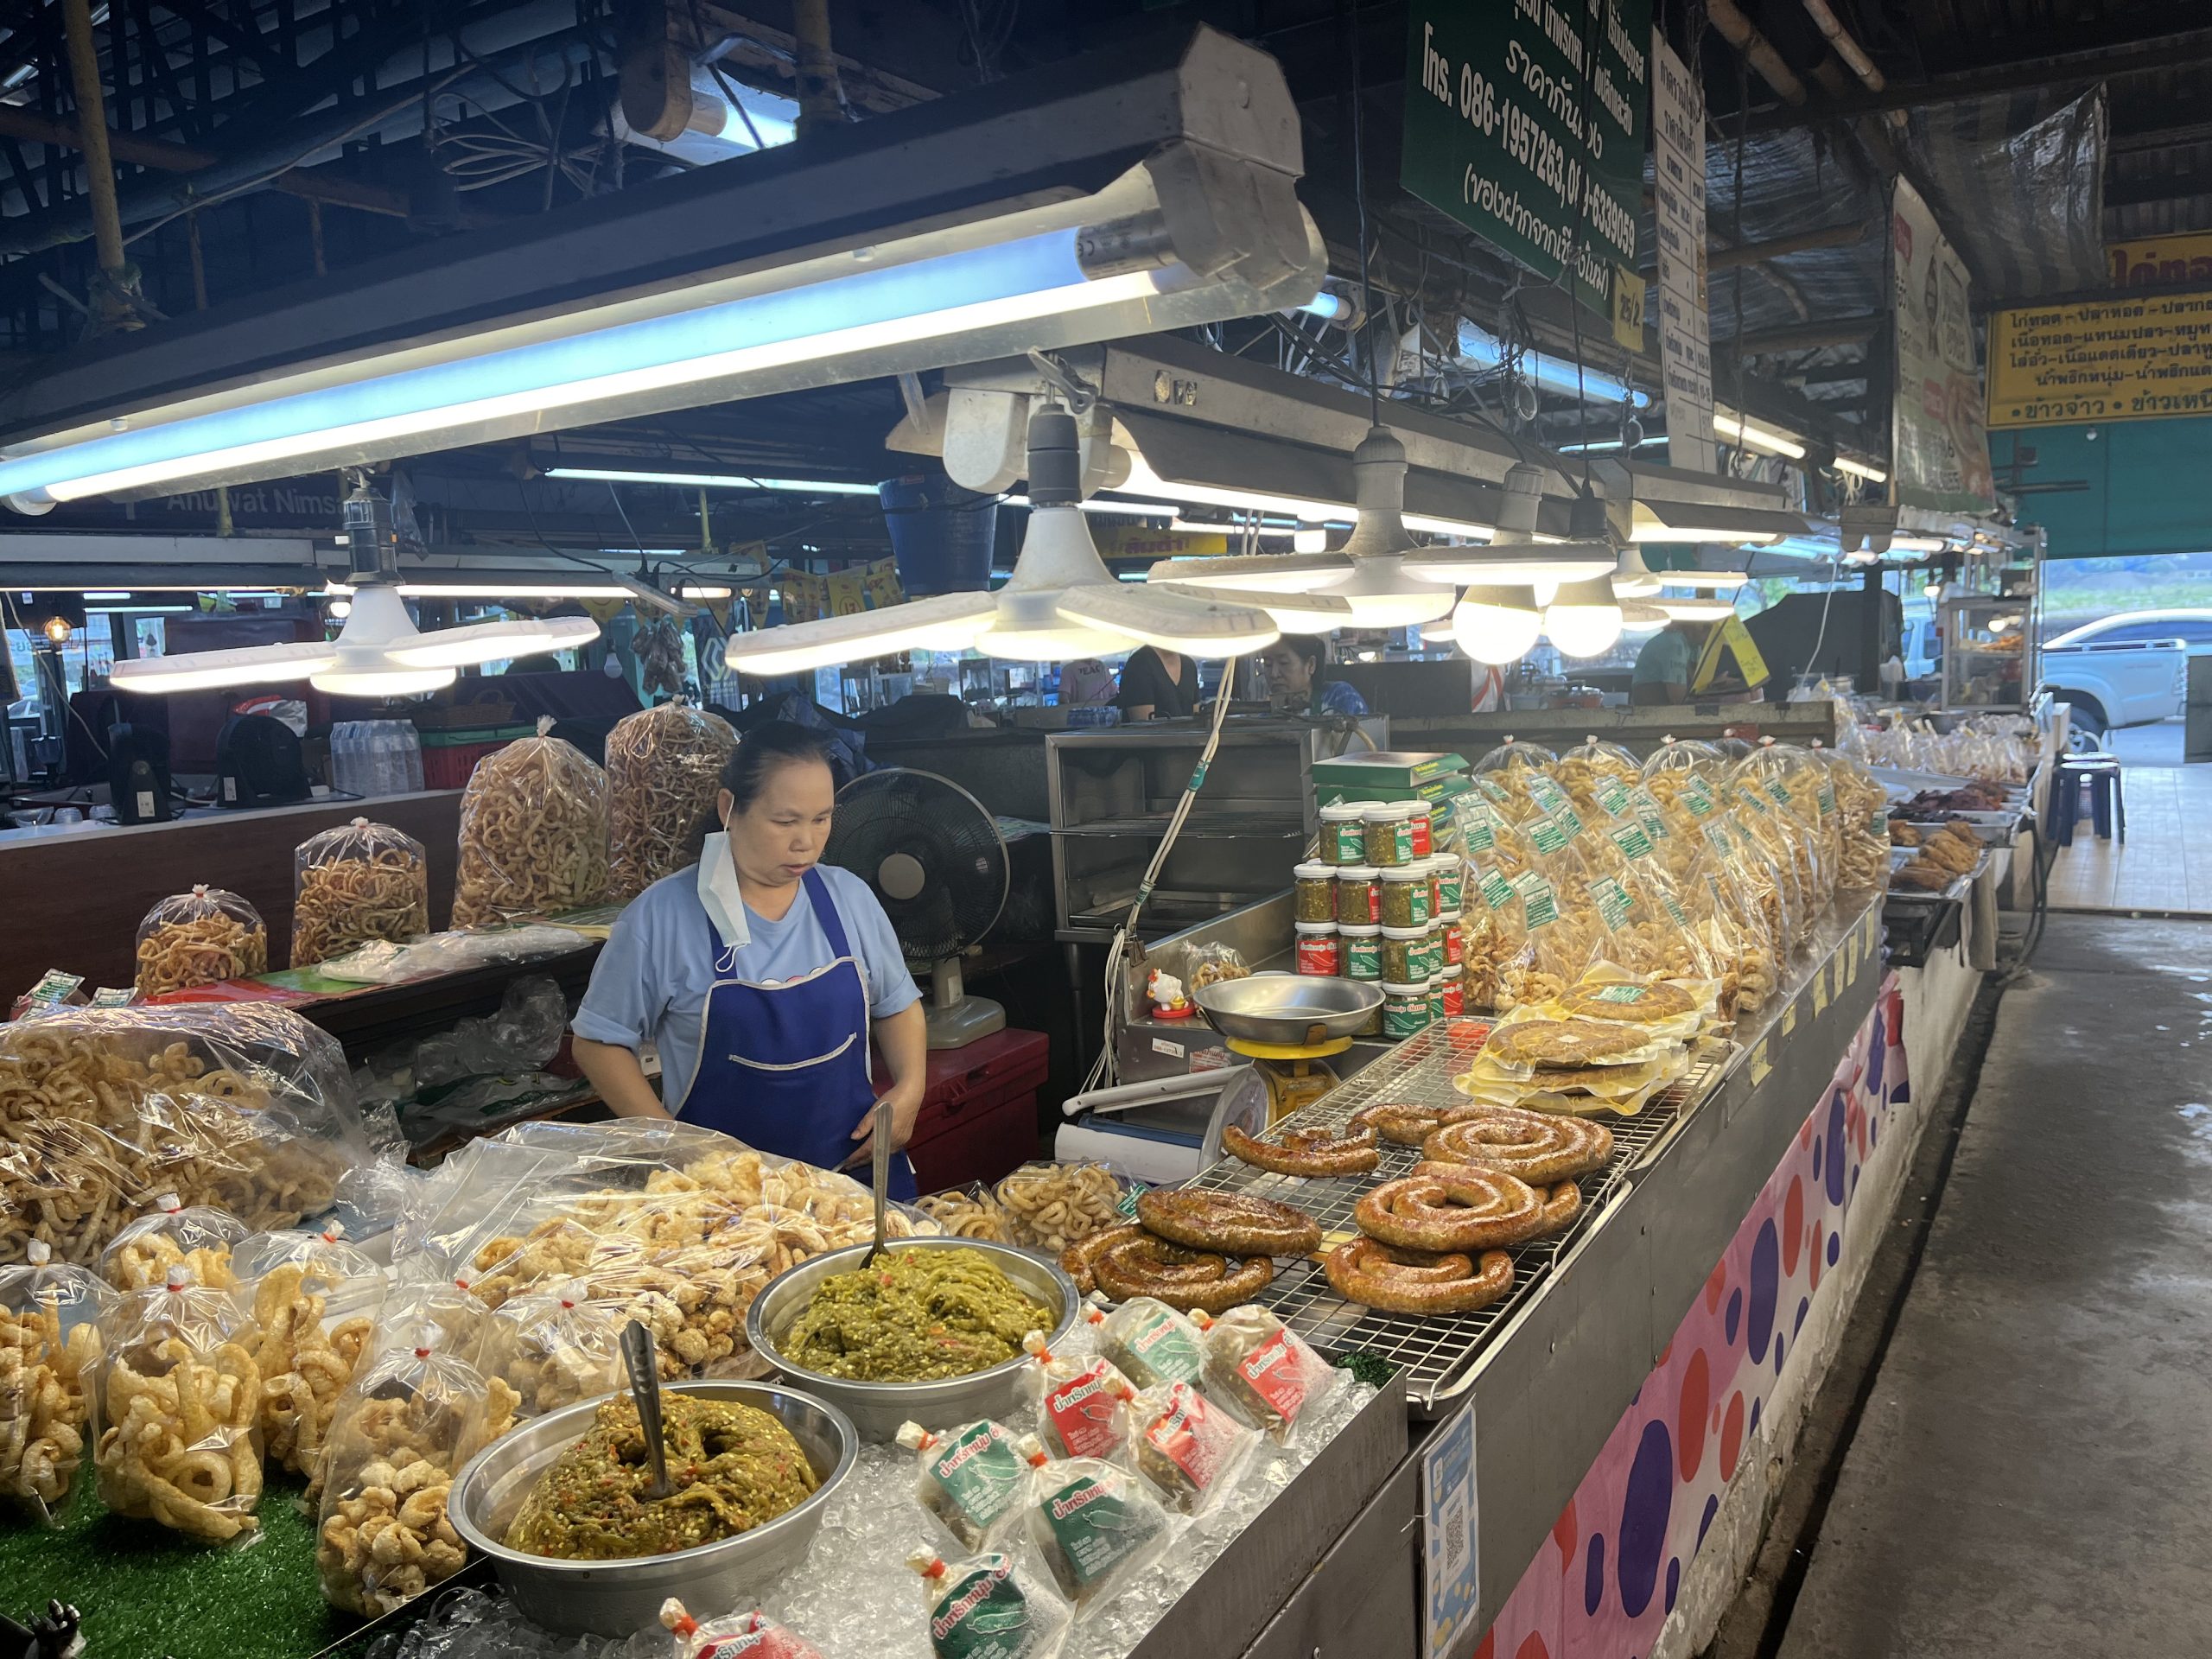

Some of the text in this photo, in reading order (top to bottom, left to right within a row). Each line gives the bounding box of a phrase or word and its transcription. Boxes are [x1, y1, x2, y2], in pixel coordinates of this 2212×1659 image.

[1422, 21, 1452, 107] โทร.
[1464, 162, 1609, 302] (ของฝากจากเชีงใหม่)
[938, 1432, 991, 1479] น้ำพริกหนุ่ม
[932, 1573, 995, 1640] น้ำพริกหนุ่ม
